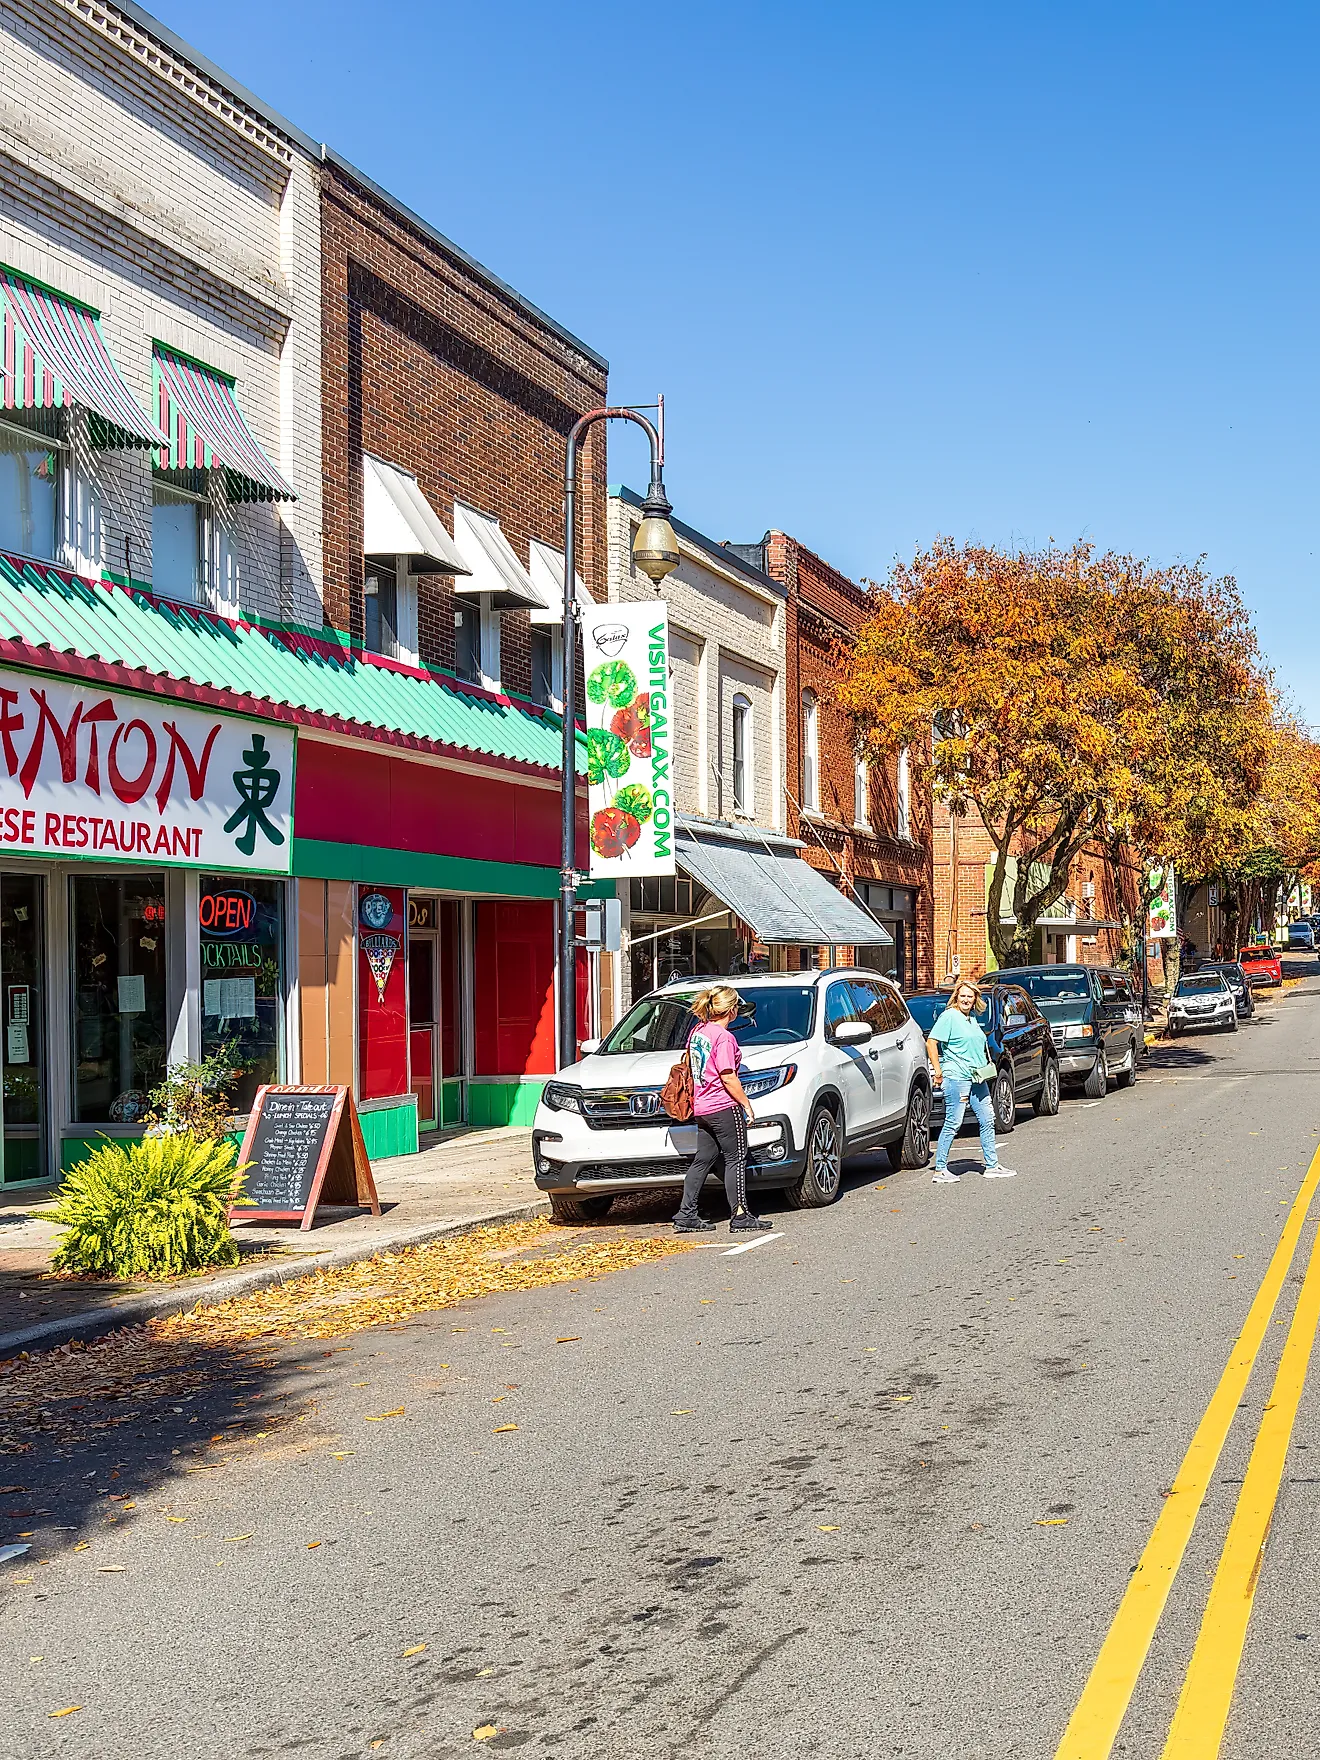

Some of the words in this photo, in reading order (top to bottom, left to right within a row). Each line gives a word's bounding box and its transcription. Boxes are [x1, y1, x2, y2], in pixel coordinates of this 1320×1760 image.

[648, 622, 671, 858] VISITGALAX.COM
[0, 807, 36, 844] SE
[44, 812, 203, 858] RESTAURANT
[200, 895, 251, 928] OPEN
[365, 936, 397, 948] BILLIARDS
